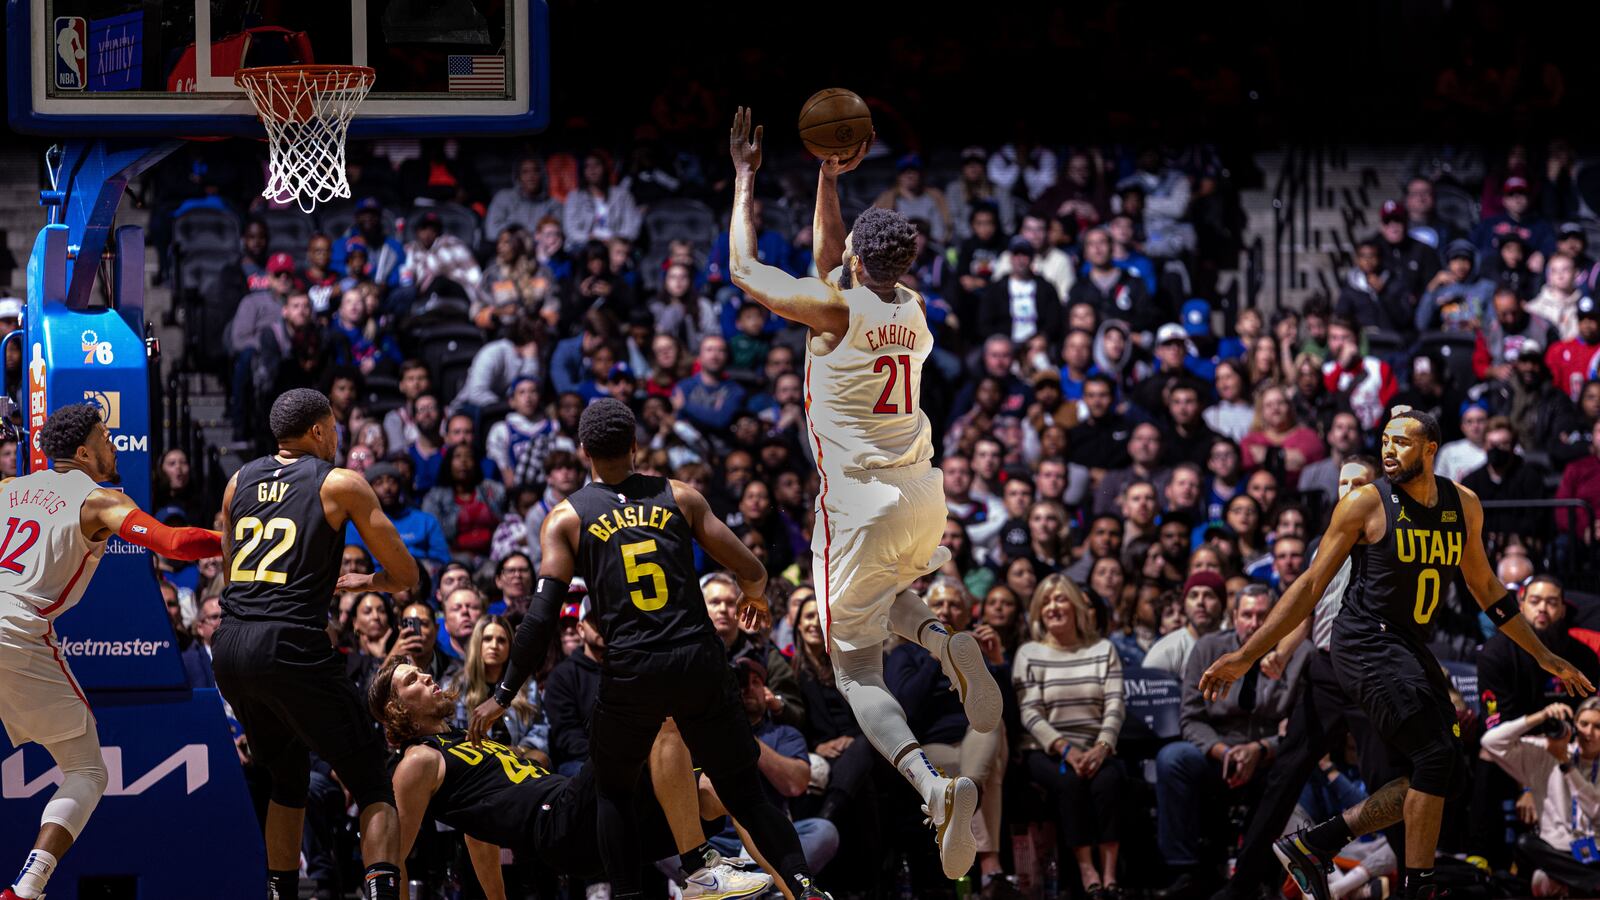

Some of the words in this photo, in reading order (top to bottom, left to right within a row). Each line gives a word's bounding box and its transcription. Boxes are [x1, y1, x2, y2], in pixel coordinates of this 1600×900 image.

[97, 25, 135, 86] xfinity
[59, 73, 75, 85] NBA
[81, 341, 114, 365] 76
[865, 324, 917, 351] EMBIID
[873, 354, 913, 415] 21
[109, 434, 148, 452] GM
[9, 489, 66, 515] HARRIS
[257, 482, 290, 503] GAY
[588, 505, 673, 543] BEASLEY
[0, 516, 41, 575] 12
[104, 540, 147, 555] edicine
[230, 516, 297, 584] 22
[1395, 528, 1462, 566] UTAH
[620, 539, 669, 611] 5
[1413, 568, 1440, 624] 0
